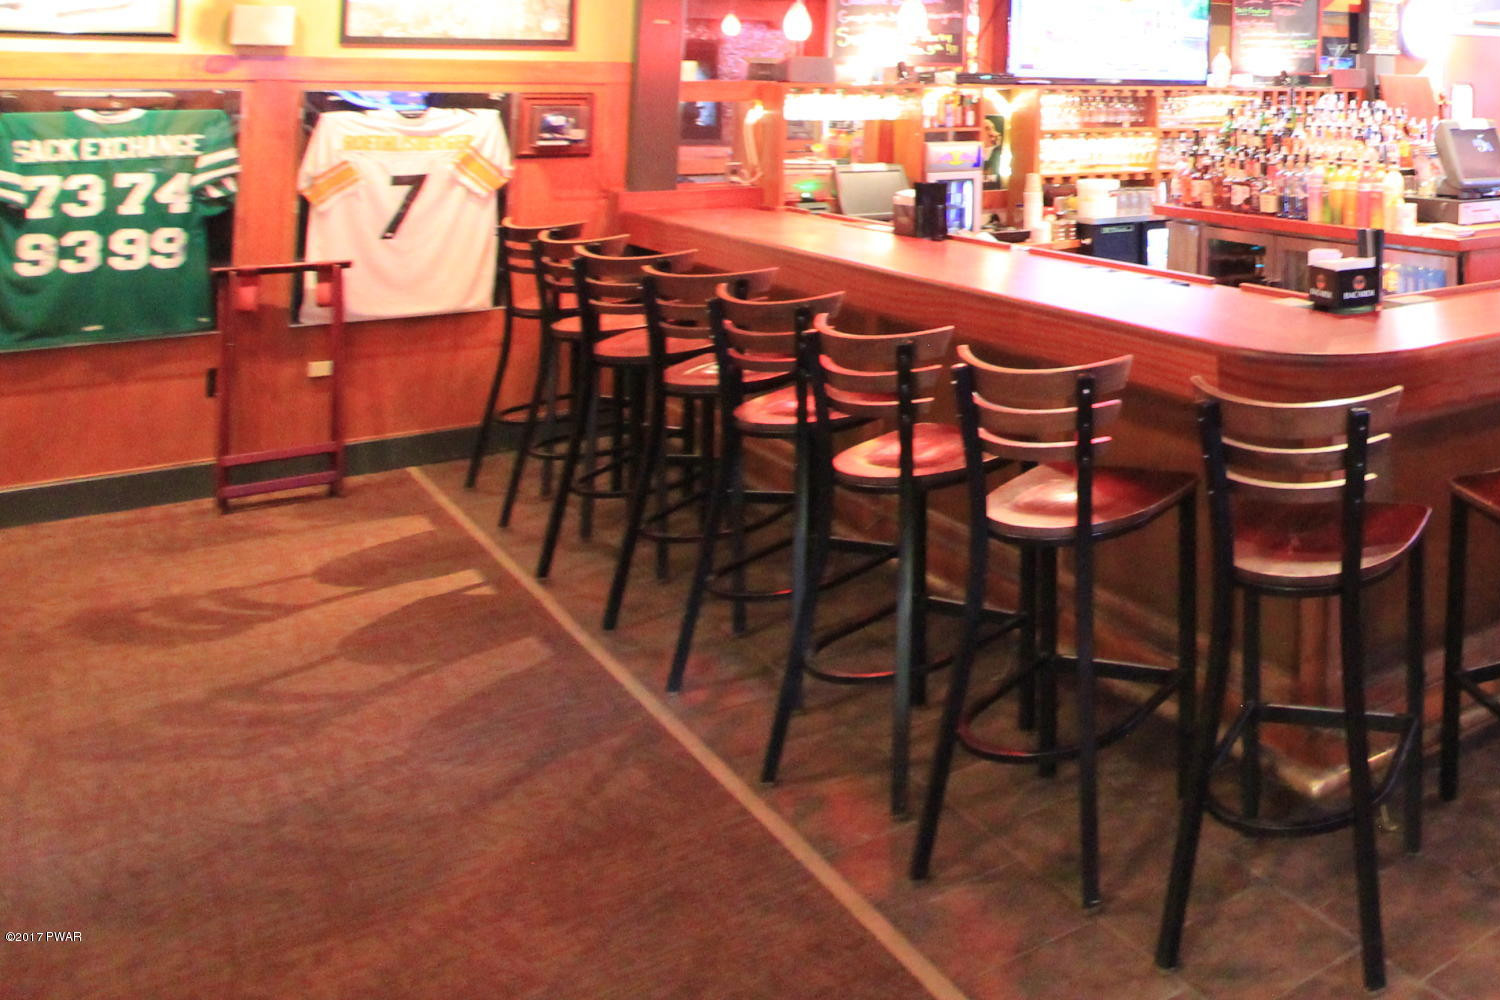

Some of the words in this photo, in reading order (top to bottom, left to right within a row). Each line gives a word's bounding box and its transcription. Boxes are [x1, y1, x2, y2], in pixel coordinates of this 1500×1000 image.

[12, 139, 79, 163] SACK
[79, 134, 206, 161] EXCHANGE
[21, 174, 106, 219] 73
[113, 173, 192, 215] 74
[380, 174, 428, 239] 7
[13, 230, 102, 277] 93
[107, 227, 188, 270] 99
